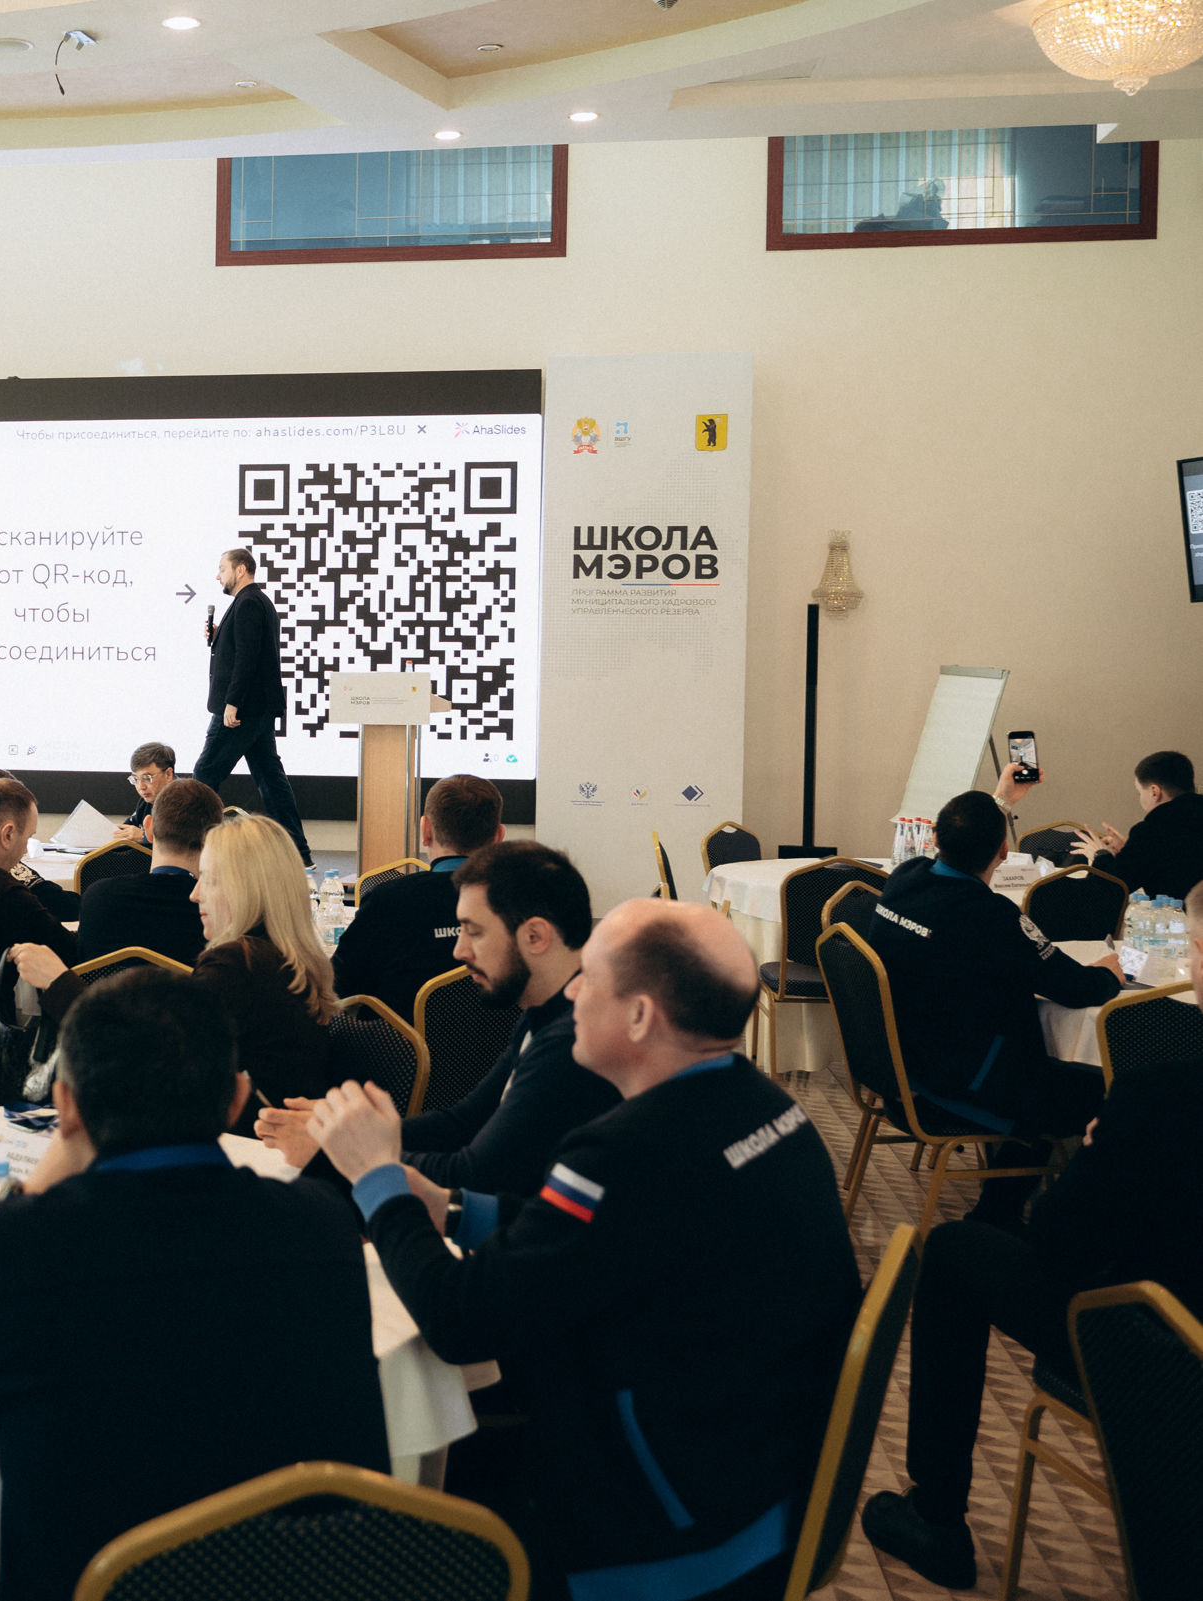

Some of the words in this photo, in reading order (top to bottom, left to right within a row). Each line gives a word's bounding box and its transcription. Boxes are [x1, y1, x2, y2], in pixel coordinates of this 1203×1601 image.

[16, 429, 54, 440] Чтобы
[58, 429, 160, 442] присоединиться,
[164, 428, 230, 441] перейдите
[256, 424, 406, 438] ahaslides.com/P3L8U
[472, 424, 526, 436] AhaSlides
[573, 525, 718, 550] ШКОЛА
[32, 563, 133, 589] QR-код,
[572, 554, 719, 580] МЭРОВ
[14, 602, 90, 623] чтобы
